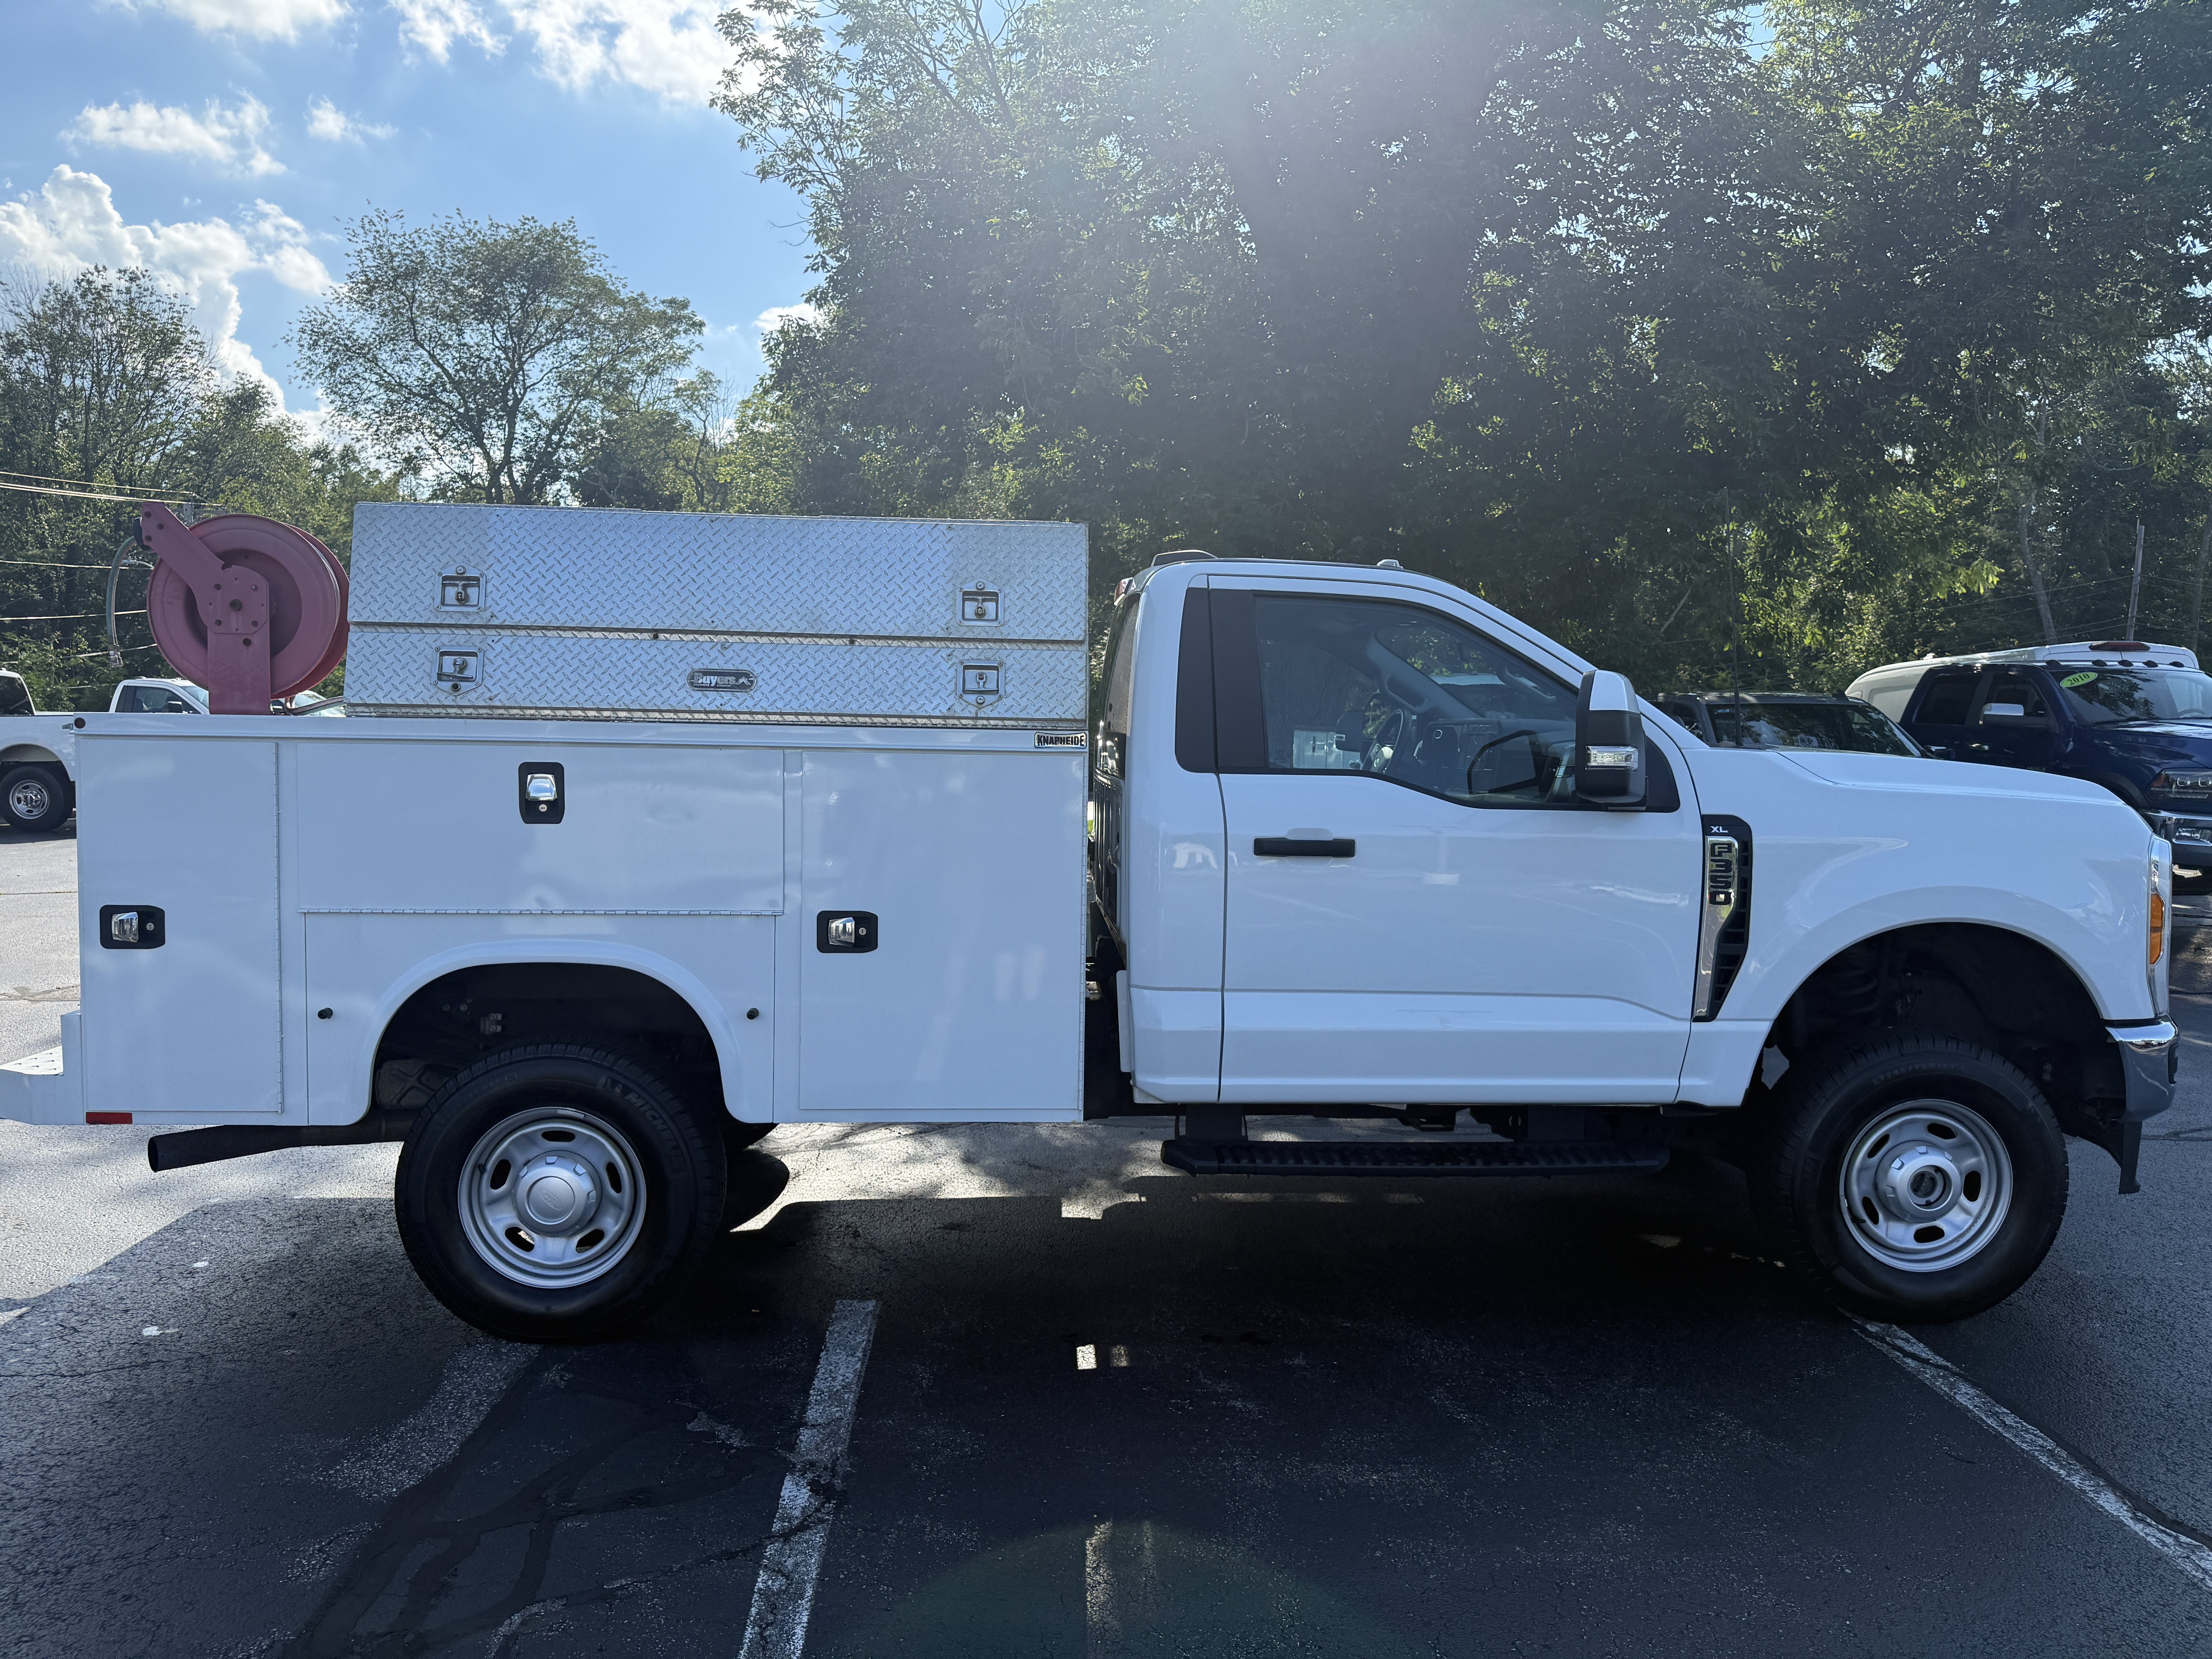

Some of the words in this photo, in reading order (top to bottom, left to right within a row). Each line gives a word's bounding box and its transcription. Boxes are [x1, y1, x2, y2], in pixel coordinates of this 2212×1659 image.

[694, 673, 736, 686] Buyers
[2067, 673, 2090, 685] 2010
[1037, 735, 1085, 746] KNAPHEIDE
